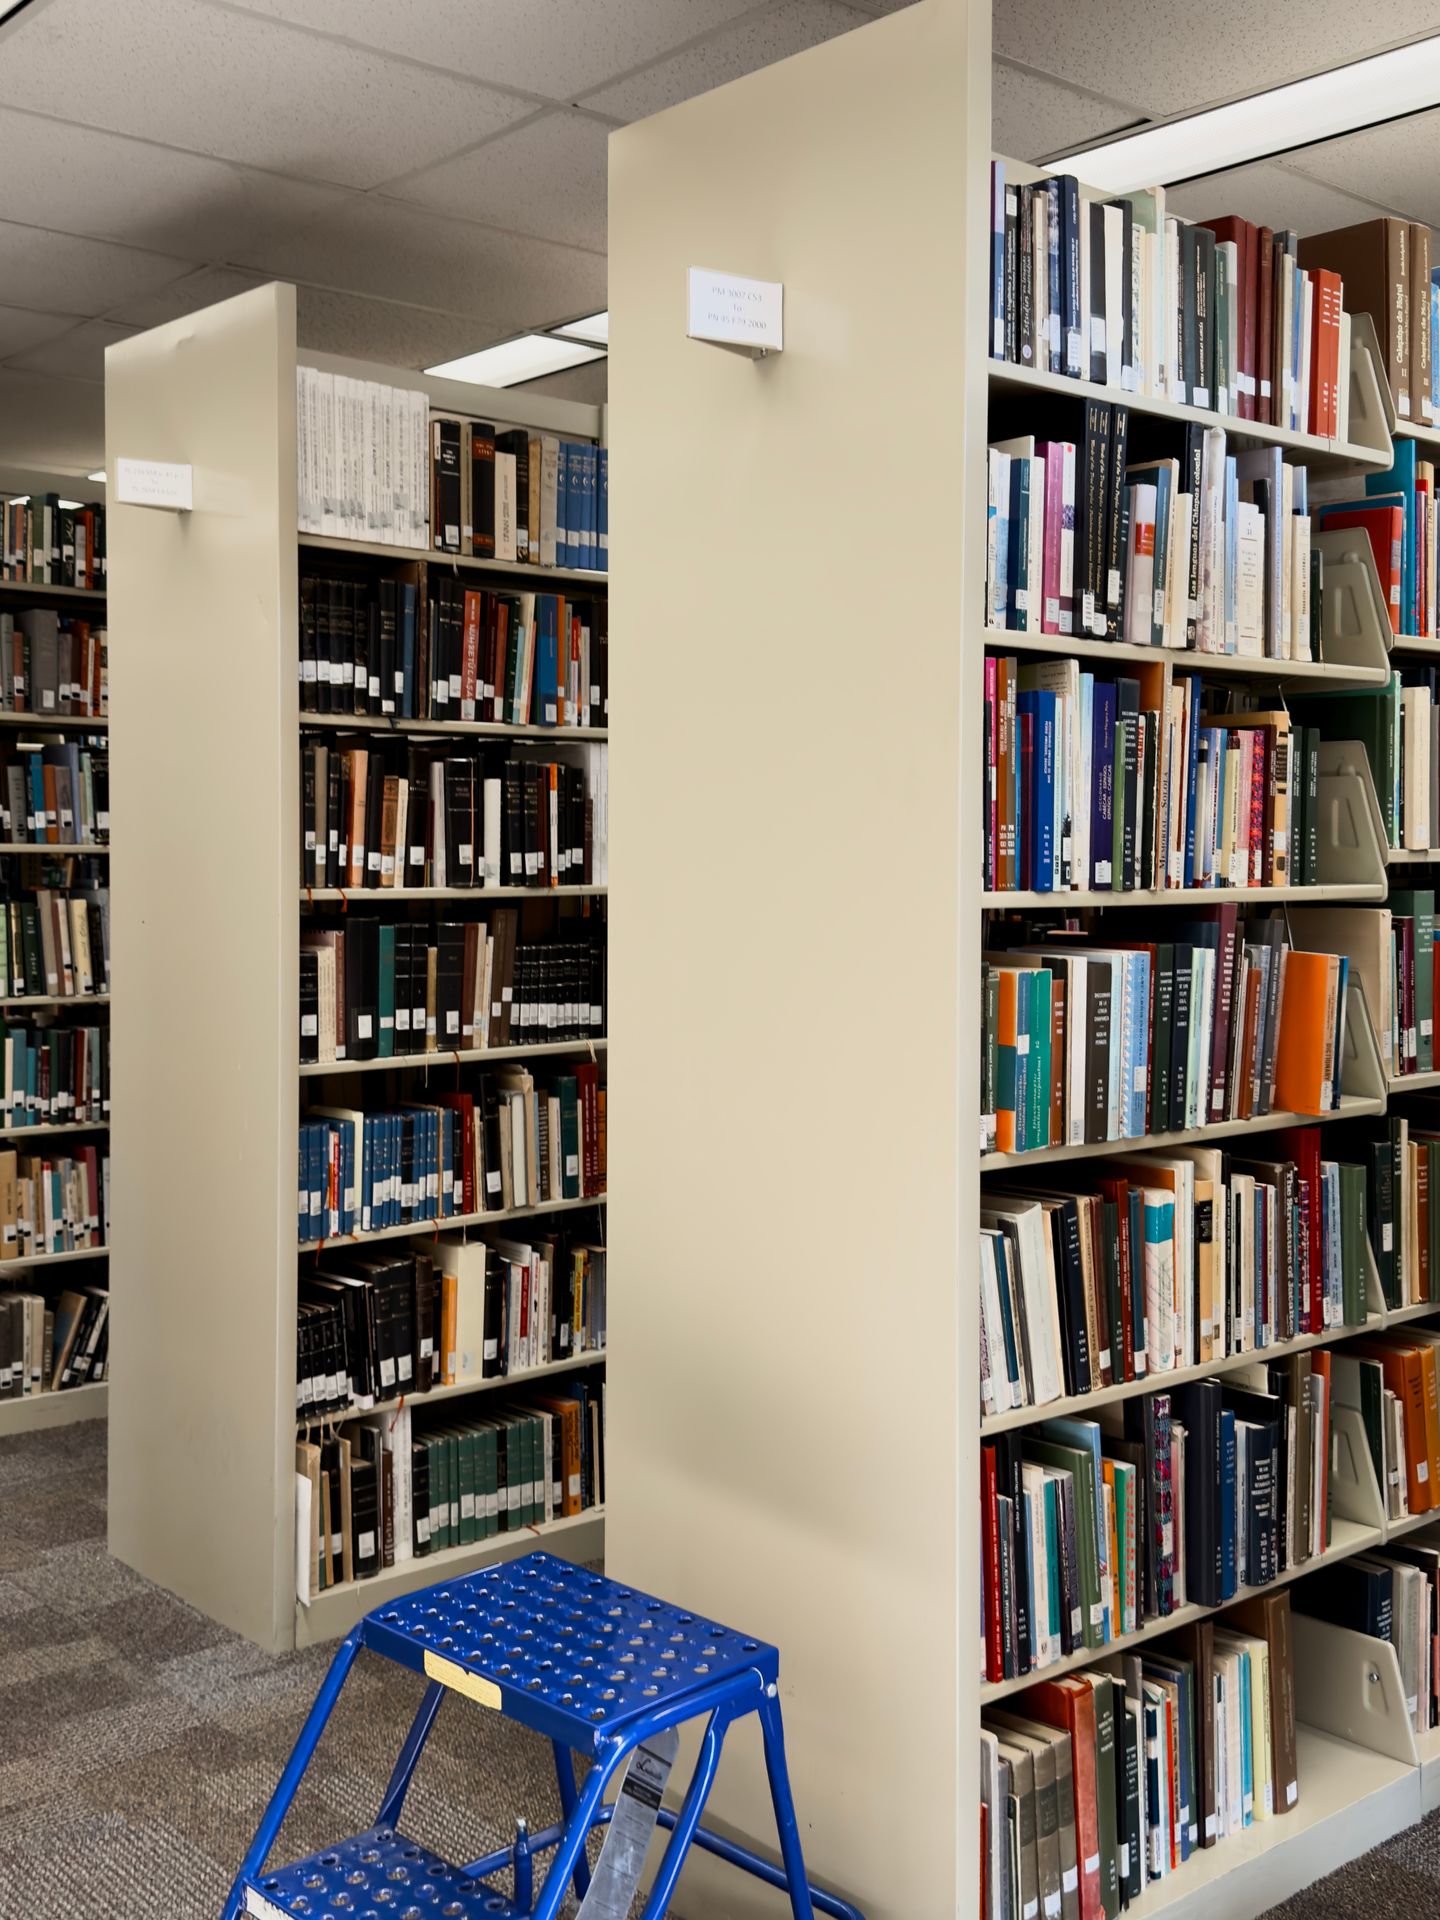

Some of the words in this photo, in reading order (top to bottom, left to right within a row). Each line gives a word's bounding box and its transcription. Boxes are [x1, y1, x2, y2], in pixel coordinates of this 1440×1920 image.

[1191, 542, 1199, 578] lenguas
[1325, 1043, 1333, 1081] DICTIONARY
[1287, 1265, 1294, 1279] of
